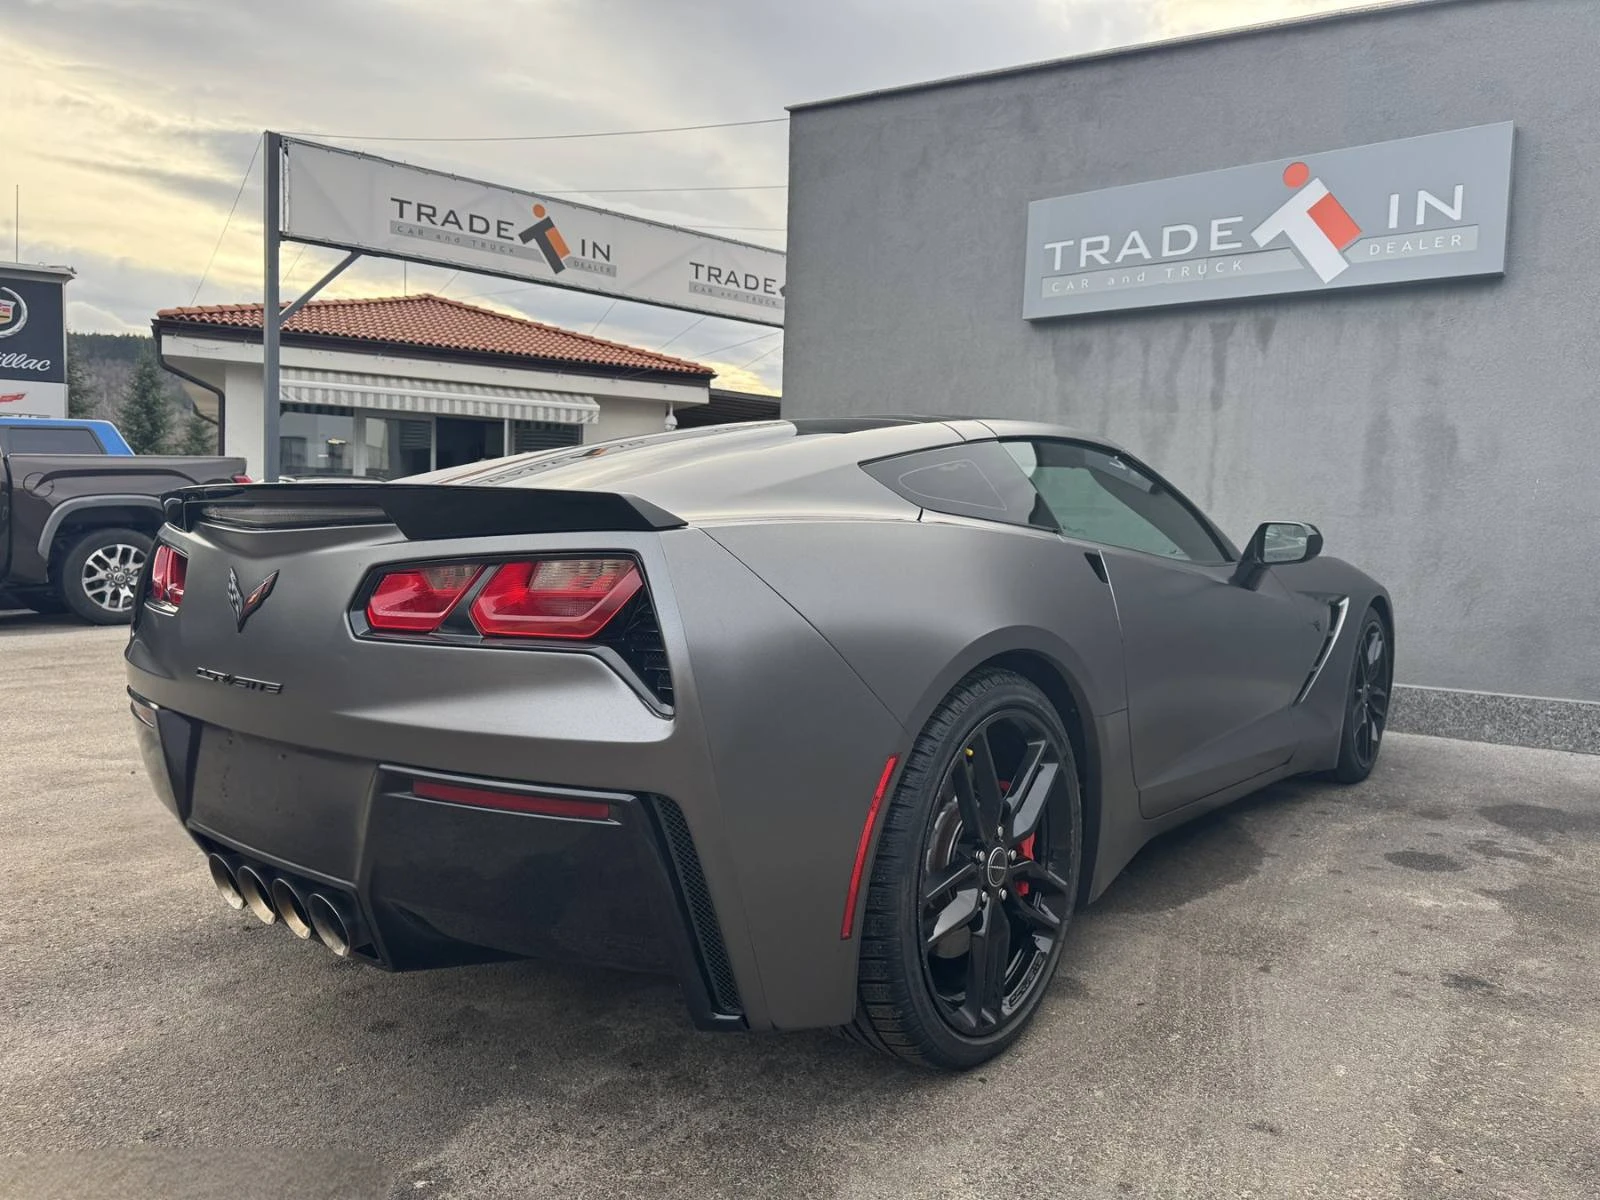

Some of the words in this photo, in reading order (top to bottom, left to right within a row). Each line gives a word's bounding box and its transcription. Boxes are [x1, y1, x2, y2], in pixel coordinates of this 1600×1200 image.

[390, 197, 516, 241] TRADE
[581, 238, 610, 262] IN
[397, 225, 425, 236] CAR
[436, 234, 461, 243] and
[472, 239, 515, 253] TRUCK
[574, 260, 611, 273] DEALER
[1044, 216, 1244, 271] TRADE
[1388, 185, 1464, 229] IN
[689, 262, 777, 295] TRADE
[1052, 279, 1089, 292] CAR
[1108, 272, 1145, 286] and
[1165, 260, 1243, 279] TRUCK
[1369, 234, 1462, 256] DEALER
[694, 285, 713, 293] CAR
[0, 352, 50, 371] illac
